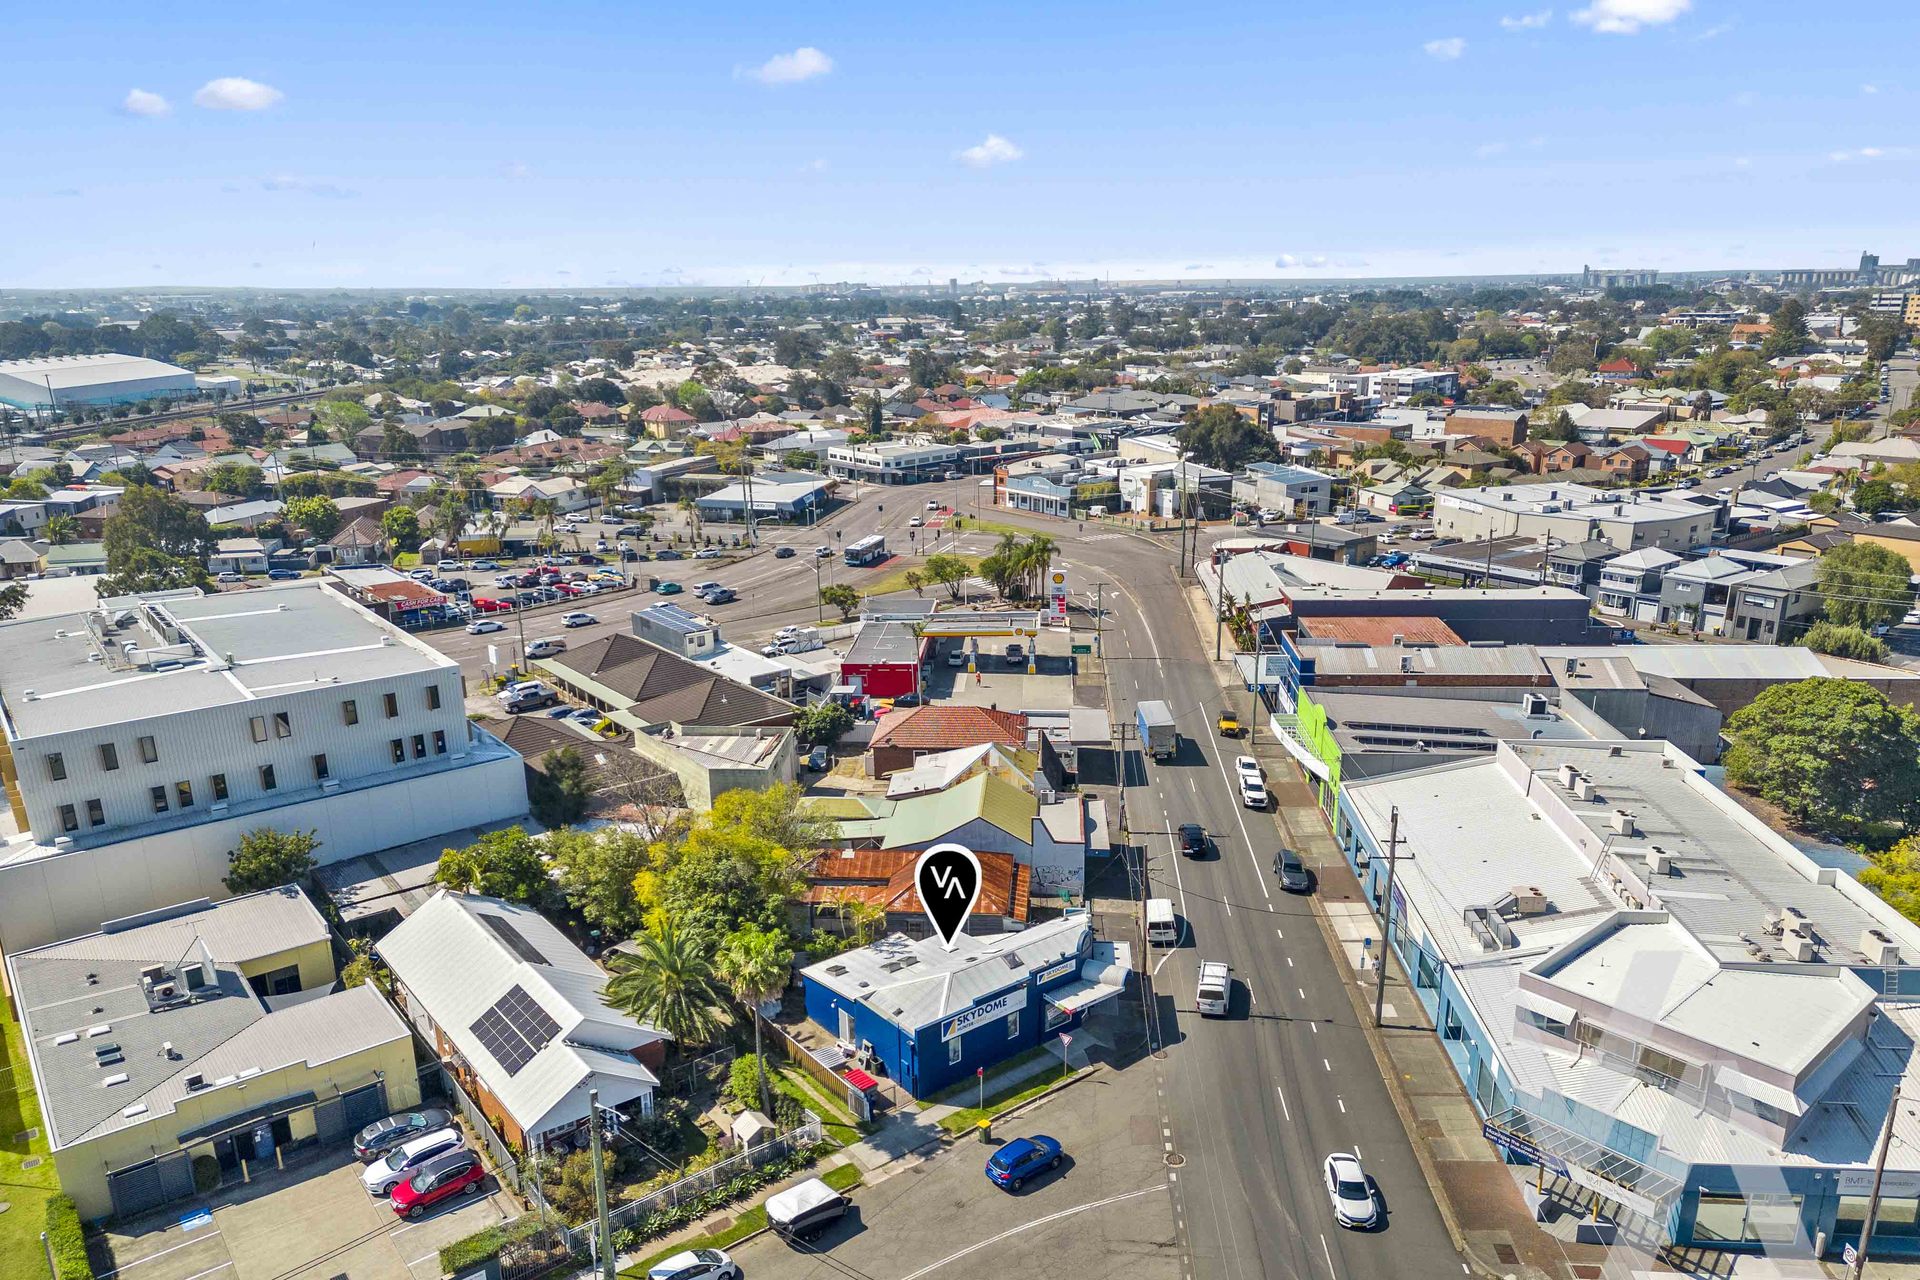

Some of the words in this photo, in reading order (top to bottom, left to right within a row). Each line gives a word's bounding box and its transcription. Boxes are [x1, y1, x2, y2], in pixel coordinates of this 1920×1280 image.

[957, 997, 1008, 1026] SKYDOME
[1485, 1132, 1498, 1141] from
[1498, 1138, 1510, 1148] your
[1510, 1144, 1539, 1161] investment
[1511, 1139, 1520, 1147] the
[1520, 1143, 1534, 1154] cash
[1845, 1176, 1864, 1185] BMT
